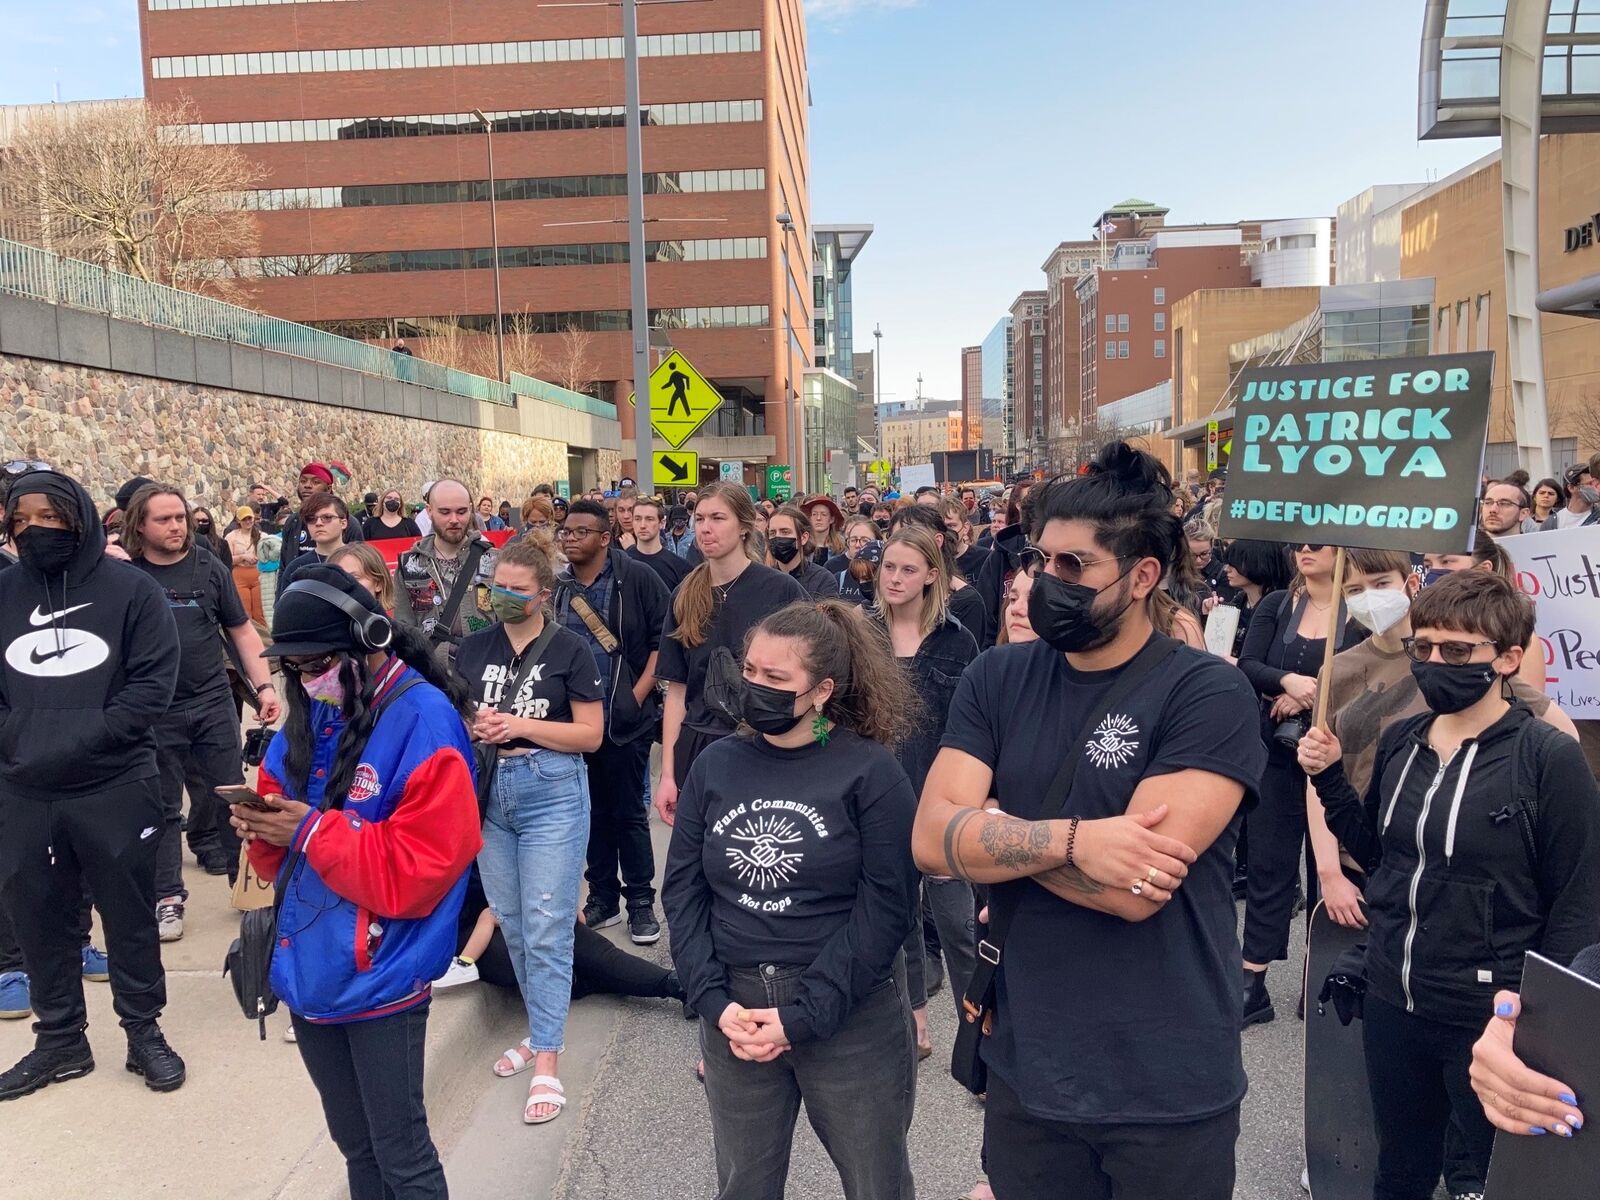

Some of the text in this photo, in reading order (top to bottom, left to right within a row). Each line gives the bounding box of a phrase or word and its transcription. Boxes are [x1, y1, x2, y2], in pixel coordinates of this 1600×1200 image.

[1242, 367, 1470, 402] JUSTICE FOR
[1244, 407, 1452, 443] PATRICK
[1242, 444, 1447, 478] LYOYA
[1230, 499, 1459, 530] #DEFUNDGRPD
[1548, 628, 1600, 671] Pe
[481, 663, 547, 683] BLK
[483, 680, 535, 704] LIES
[712, 798, 829, 839] Fund Communities
[738, 893, 792, 913] Not Cops
